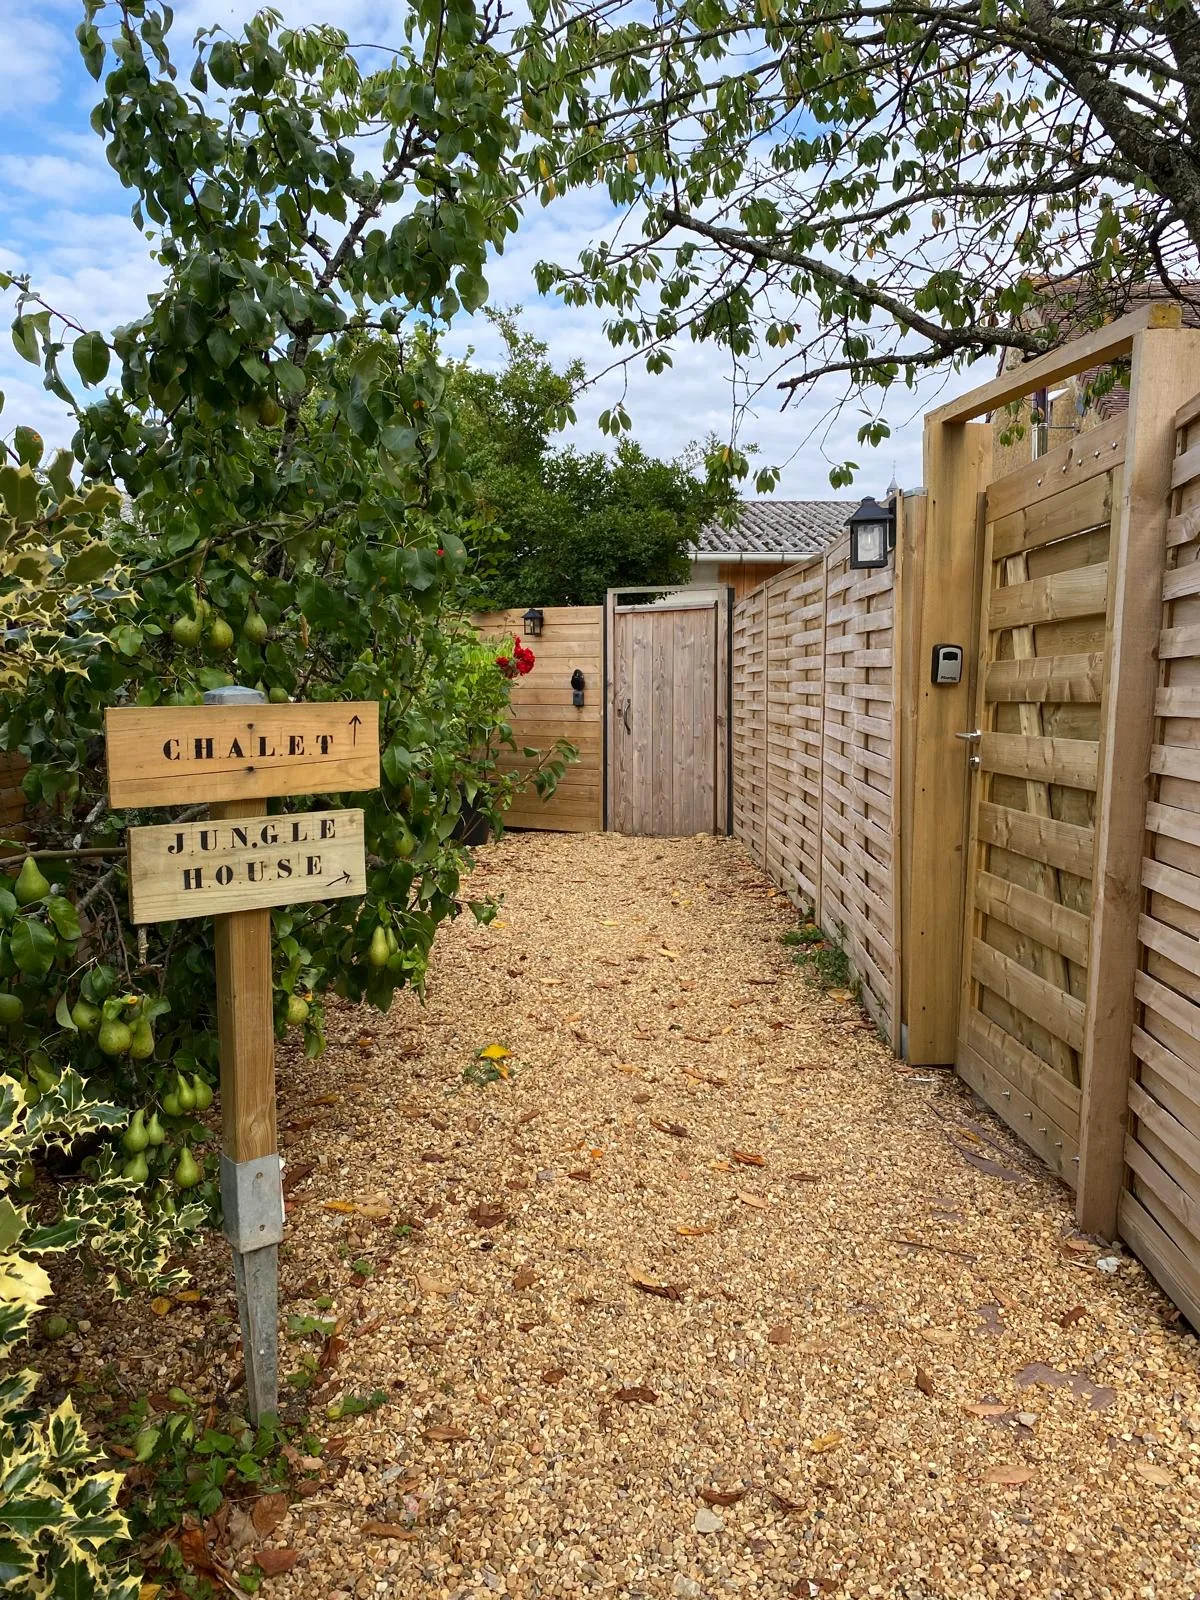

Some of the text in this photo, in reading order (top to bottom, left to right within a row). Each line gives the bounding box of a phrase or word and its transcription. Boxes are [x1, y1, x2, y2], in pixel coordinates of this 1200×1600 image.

[163, 735, 334, 761] CHALET
[167, 819, 336, 855] JUNGLE
[183, 855, 322, 890] HOUSE
